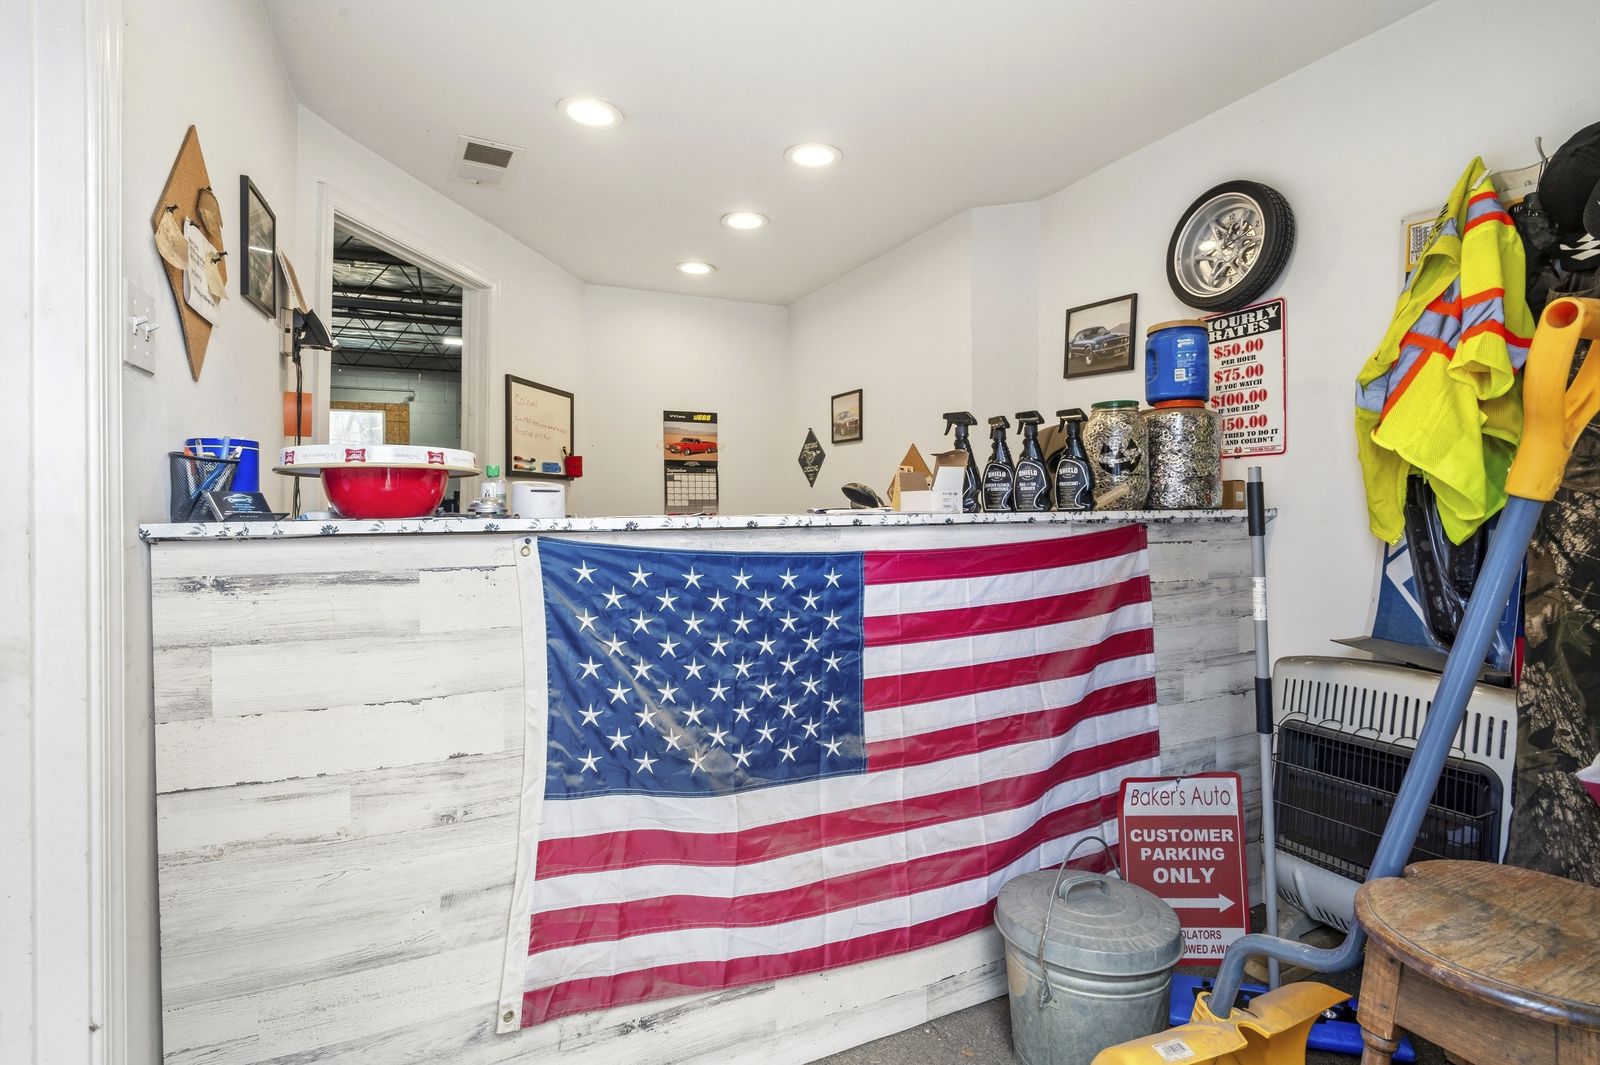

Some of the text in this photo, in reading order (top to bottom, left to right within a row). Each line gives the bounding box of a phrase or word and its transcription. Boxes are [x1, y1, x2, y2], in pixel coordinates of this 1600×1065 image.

[1209, 319, 1270, 343] RATES
[1214, 338, 1264, 360] $50.00
[1237, 354, 1257, 364] HOUR
[1214, 363, 1264, 384] $75.00
[1224, 381, 1238, 390] YOU
[1239, 379, 1263, 388] WATCH
[1210, 388, 1268, 409] $100.00
[1241, 404, 1260, 412] HELP
[1222, 414, 1268, 432] 150.00
[1240, 436, 1275, 444] COULDN'T
[1130, 785, 1231, 806] Baker's Auto
[1130, 829, 1234, 842] CUSTOMER
[1140, 847, 1225, 861] PARKING
[1152, 867, 1215, 884] ONLY
[1180, 930, 1222, 940] OLATORS
[1184, 944, 1209, 954] OWED
